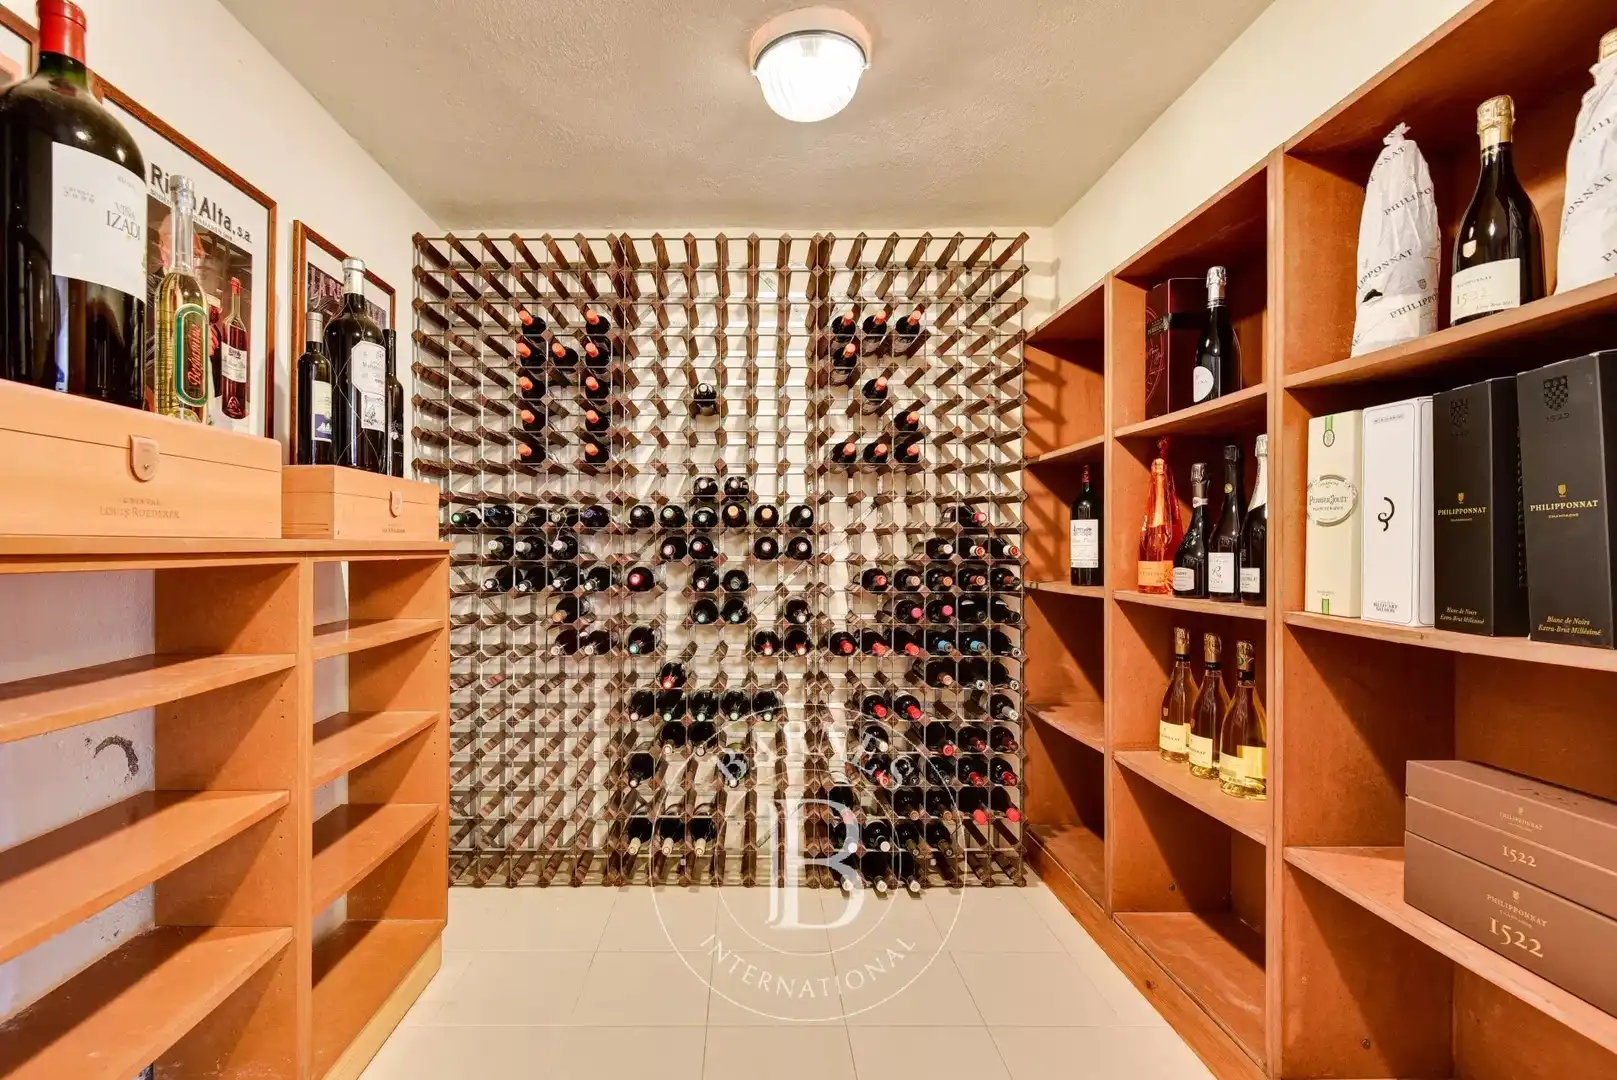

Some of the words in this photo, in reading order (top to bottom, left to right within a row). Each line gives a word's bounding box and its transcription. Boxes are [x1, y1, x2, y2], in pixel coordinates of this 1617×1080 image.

[106, 210, 140, 240] IZADI
[1437, 507, 1487, 516] PHILIPPONNAT
[1529, 500, 1599, 512] PHILIPPONNAT
[1538, 624, 1571, 634] Extra-Brut
[1546, 615, 1564, 624] Blanc
[1564, 617, 1573, 625] de
[1572, 617, 1591, 626] Noirs
[1502, 845, 1537, 868] 1522
[1486, 893, 1548, 928] PHILIPPONNAT
[1488, 916, 1544, 959] 1522
